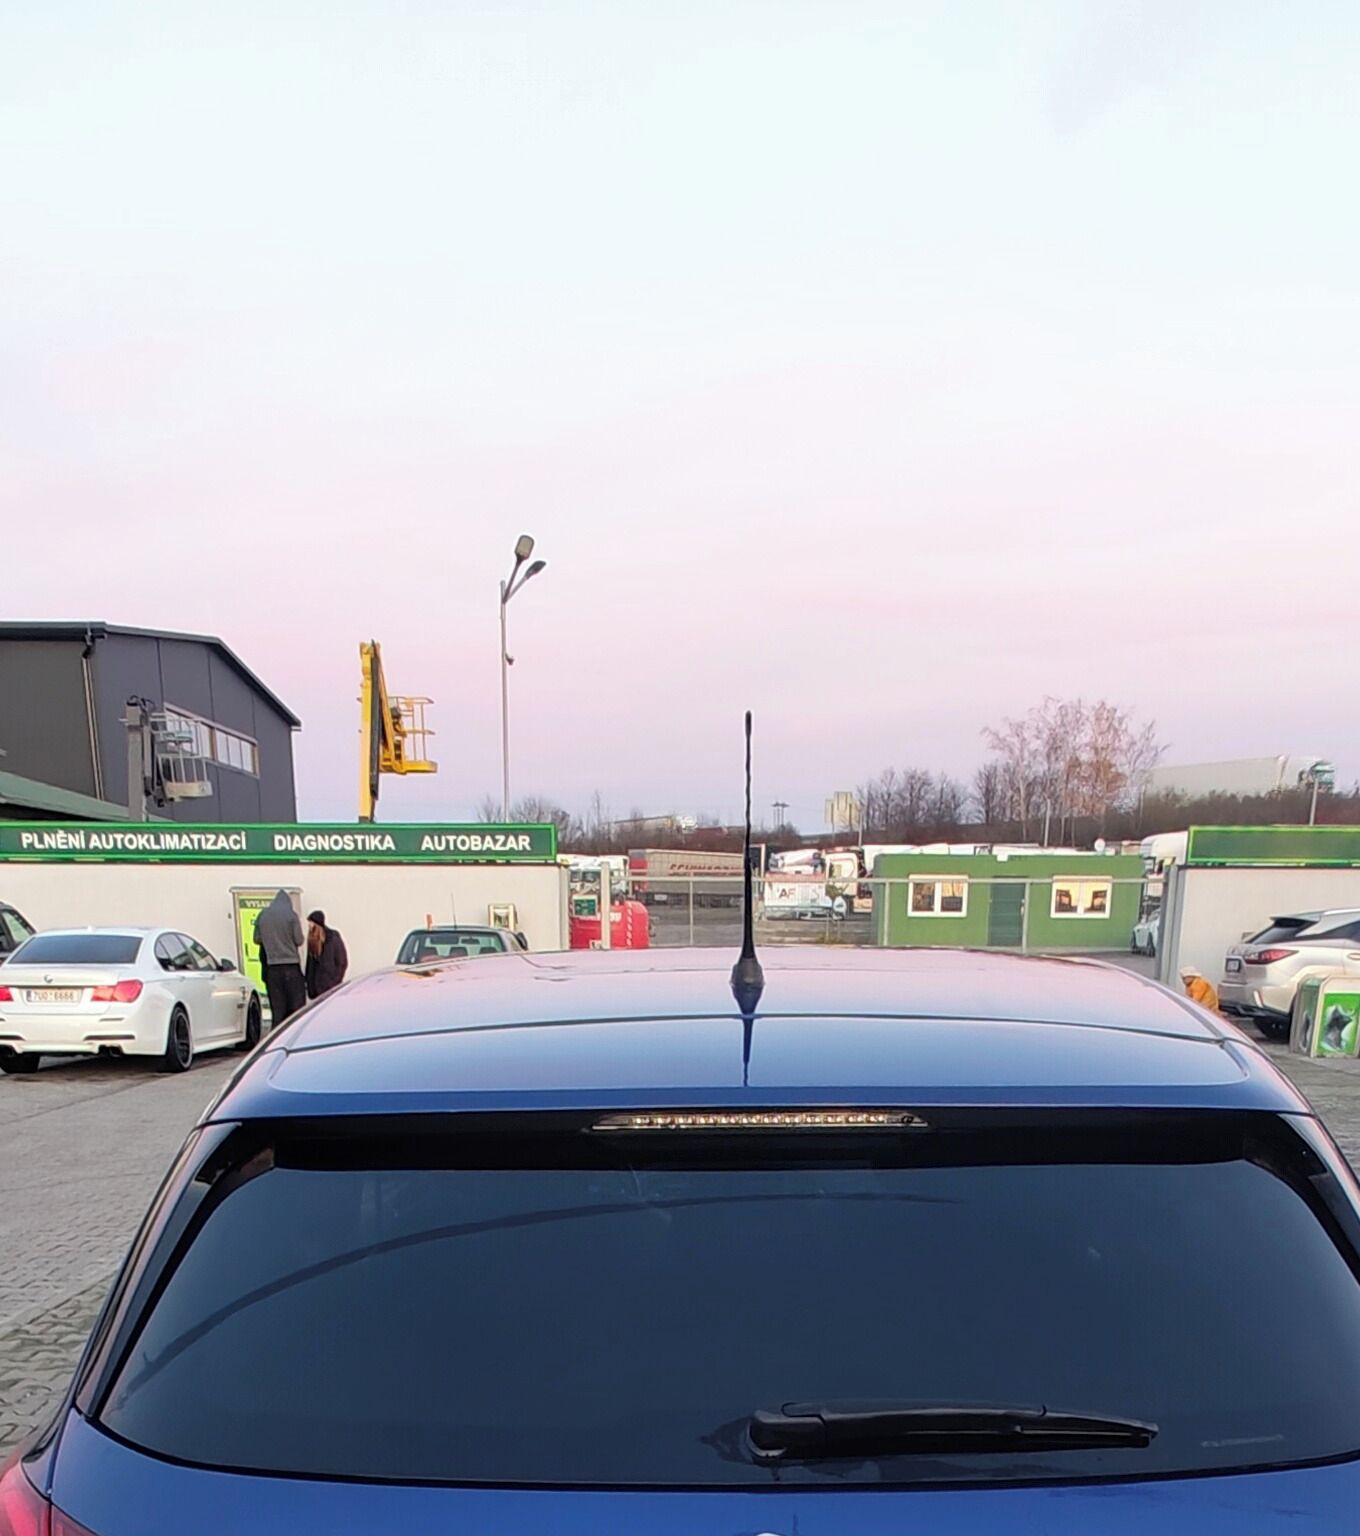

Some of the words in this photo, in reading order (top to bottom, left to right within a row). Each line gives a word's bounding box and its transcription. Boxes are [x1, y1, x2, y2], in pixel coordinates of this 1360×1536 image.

[21, 829, 85, 849] PLNĚNÍ
[89, 831, 246, 850] AUTOKLIMATIZACÍ
[273, 834, 396, 850] DIAGNOSTIKA
[421, 834, 532, 851] AUTOBAZAR
